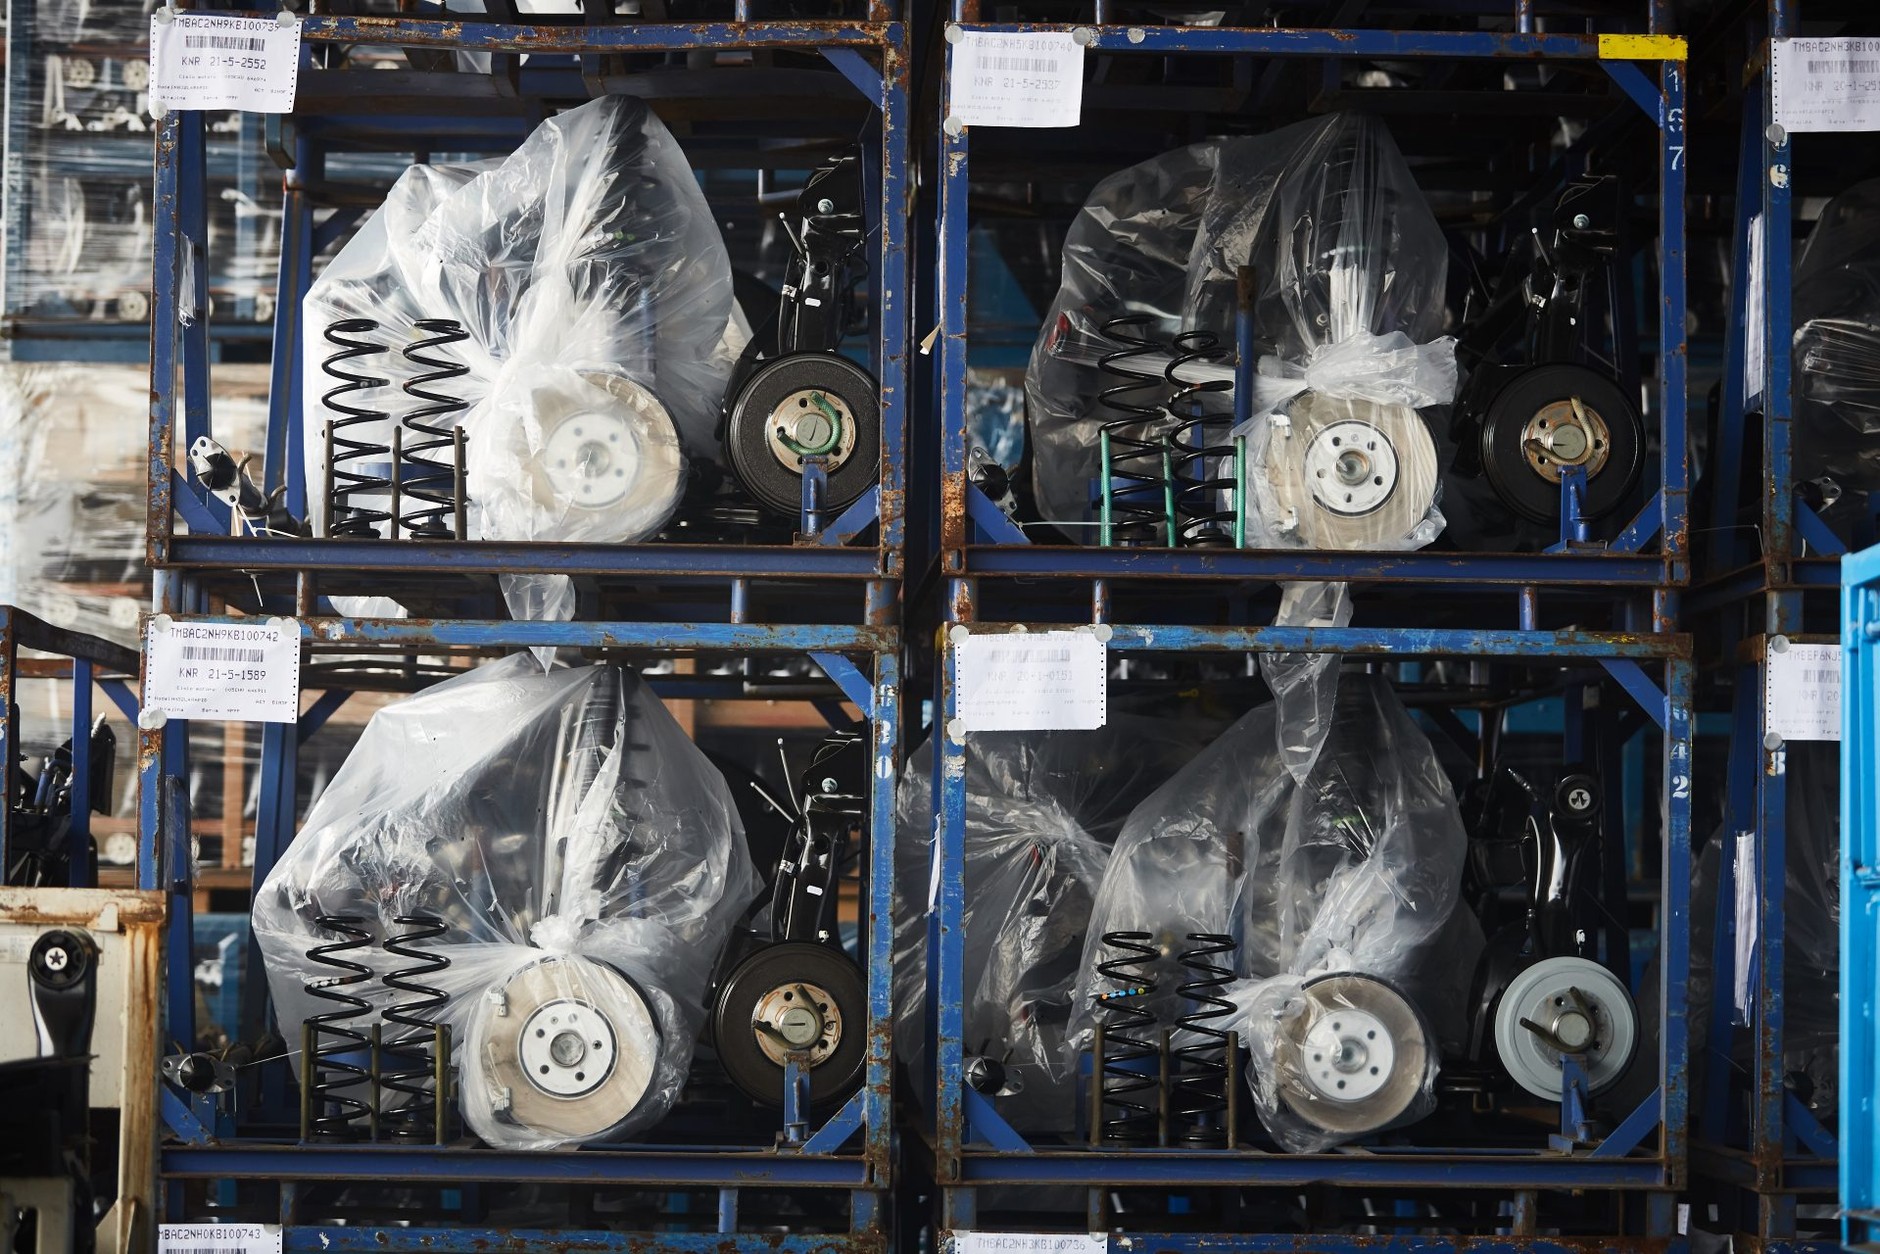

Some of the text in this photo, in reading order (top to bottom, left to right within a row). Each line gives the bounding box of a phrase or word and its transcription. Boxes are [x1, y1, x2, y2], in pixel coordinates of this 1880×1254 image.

[181, 56, 267, 70] KNR 21-5-2552
[170, 627, 279, 642] TMBAC2NH9KB100742
[179, 667, 267, 681] KNR 21-5-1589
